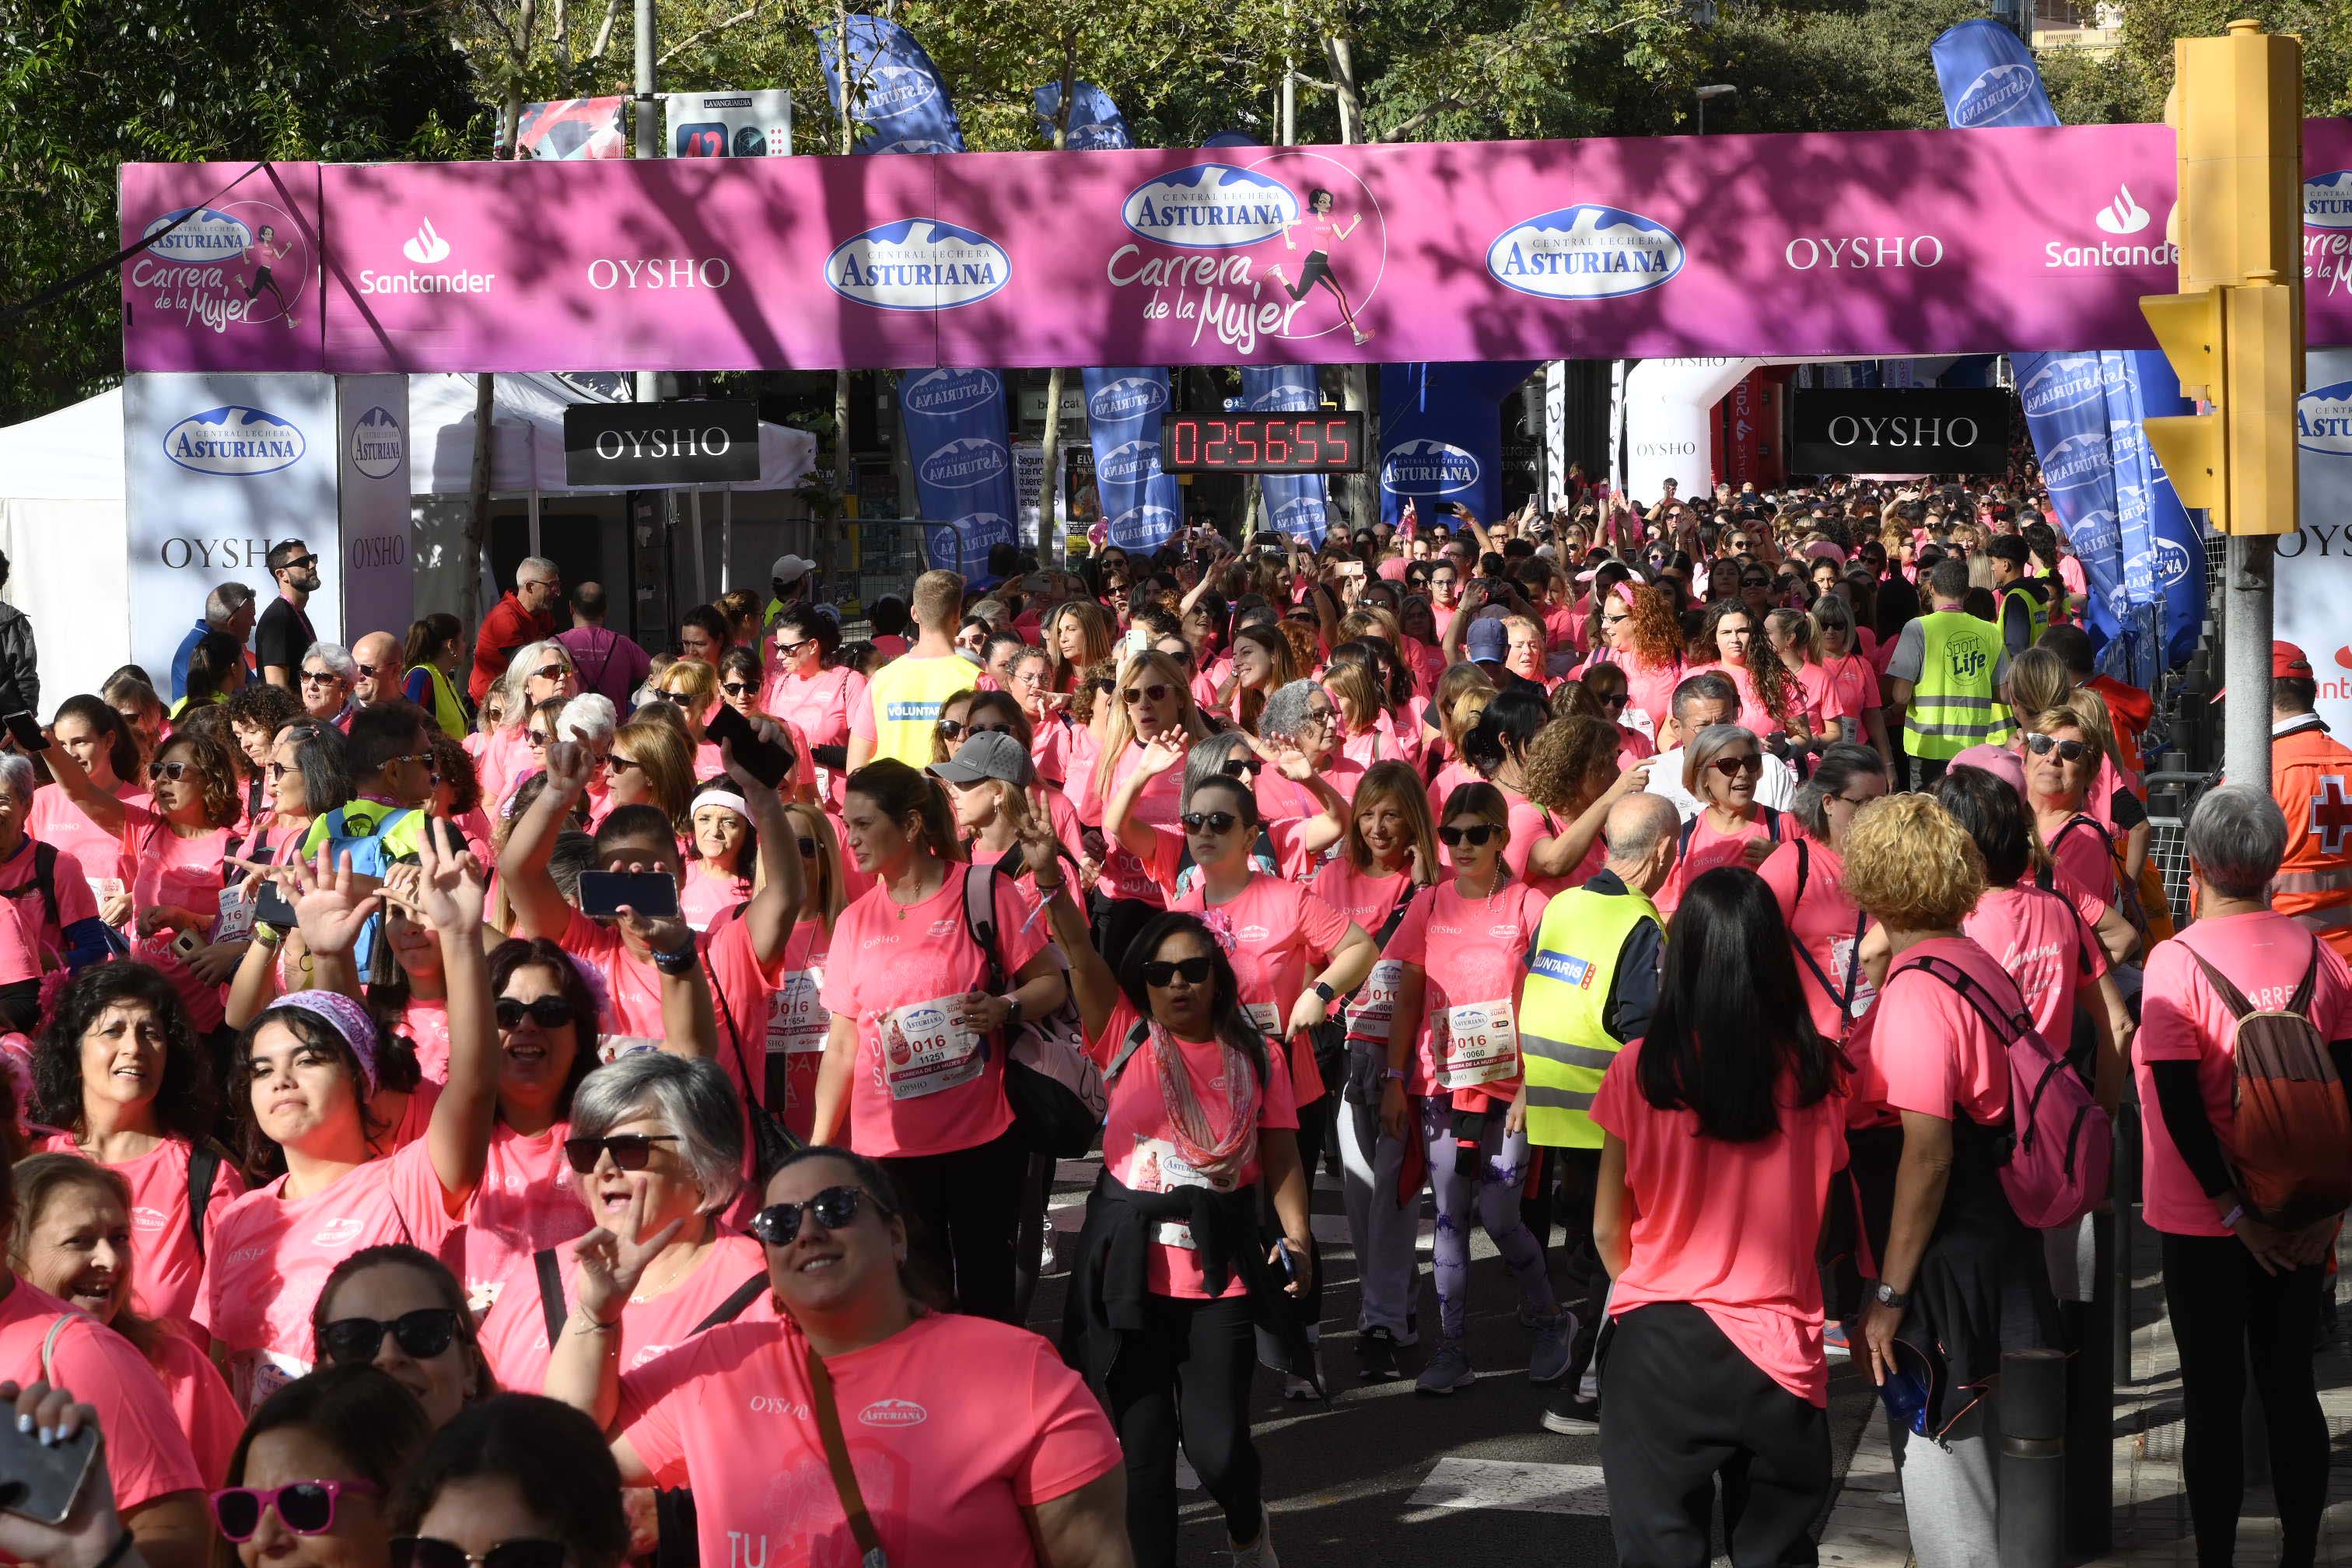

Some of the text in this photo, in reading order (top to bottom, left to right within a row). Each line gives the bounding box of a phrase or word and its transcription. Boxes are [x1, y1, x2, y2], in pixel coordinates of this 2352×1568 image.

[1136, 195, 1285, 227] ASTURIANA
[1533, 236, 1663, 247] CENTRAL LECHERA
[868, 249, 990, 260] CENTRAL LECHERA
[1503, 241, 1669, 275] ASTURIANA
[1786, 235, 1943, 270] OYSHO
[2045, 241, 2178, 268] Santande
[132, 258, 223, 288] Carrera
[586, 257, 730, 289] OYSHO
[838, 254, 996, 287] ASTURIANA
[1108, 244, 1252, 287] Carrera
[2318, 257, 2331, 278] la
[360, 270, 495, 293] Santander
[155, 285, 257, 333] de la Mujer
[1143, 282, 1307, 355] de la Mujer
[2315, 406, 2352, 415] CENTR
[1829, 415, 1978, 447] OYSHO
[174, 432, 296, 458] ASTURIANA
[355, 433, 400, 461] ASTURIANA
[596, 427, 730, 460] OYSHO
[1175, 421, 1349, 464] 02:56:55
[1636, 441, 1696, 456] OYSHO
[1077, 455, 1094, 464] ELV
[1384, 463, 1472, 483] ASTURIANA
[161, 538, 306, 569] OYSH
[353, 534, 404, 569] OYSHO
[1946, 636, 1981, 657] Sport
[1953, 650, 1986, 677] Life
[888, 706, 941, 717] VOLUNTAR
[1693, 856, 1724, 868] OYSHO
[1121, 878, 1158, 894] SUM
[226, 909, 243, 922] 16
[1343, 905, 1375, 915] OYSHO
[223, 923, 236, 933] 654
[1430, 926, 1462, 934] OYSHO
[1374, 971, 1401, 981] ASTURIAN
[1857, 989, 1877, 999] CARRE
[2248, 985, 2299, 1007] ARRE
[947, 1005, 963, 1014] SUM
[905, 1015, 943, 1031] ASTURIANA
[1452, 1017, 1486, 1028] ASTURIANA
[912, 1034, 947, 1053] 016
[1458, 1034, 1487, 1050] 016
[919, 1051, 946, 1065] 11251
[1462, 1049, 1485, 1059] 10060
[899, 1068, 924, 1080] CARRERA
[943, 1060, 961, 1070] MUJER
[899, 1080, 927, 1093] OYSHO
[135, 1218, 165, 1227] URIANA
[226, 1247, 267, 1263] OYSH
[864, 1409, 921, 1421] ASTURIANA
[727, 1530, 767, 1568] TU
